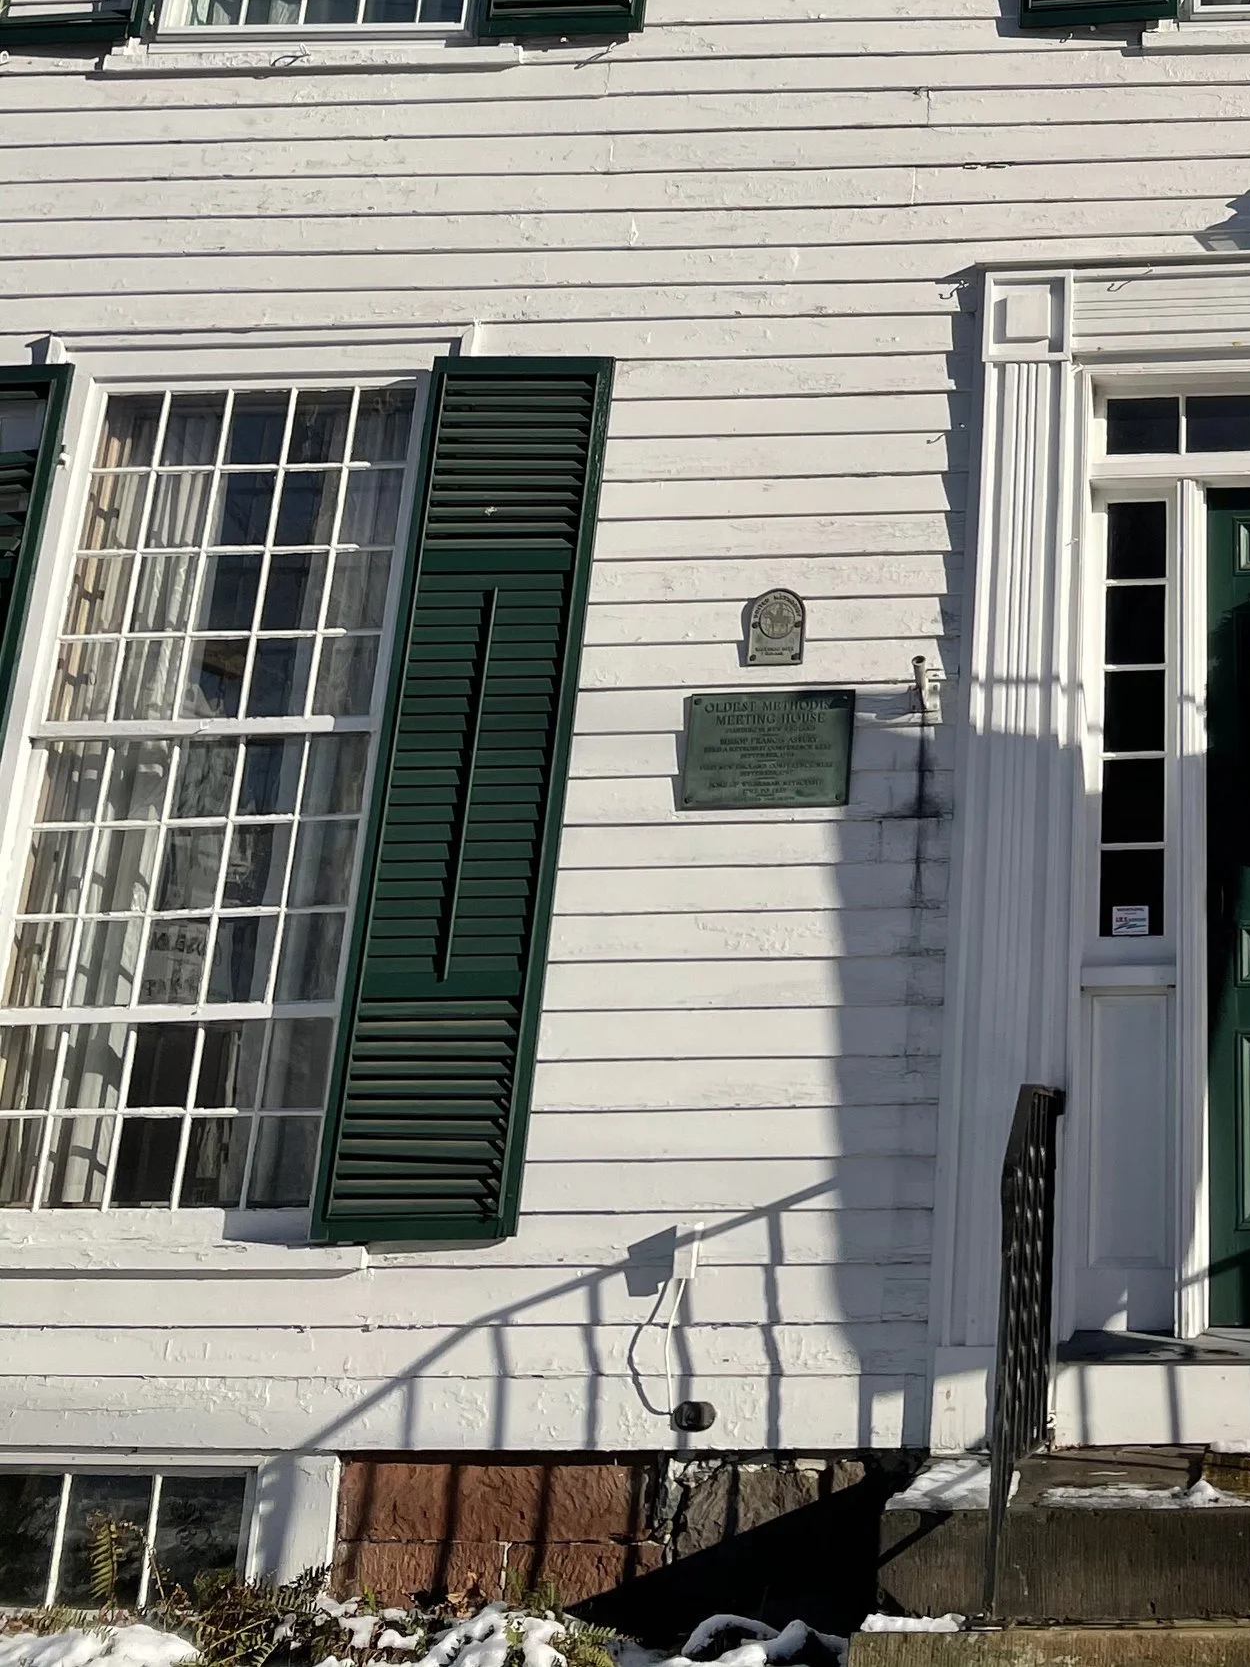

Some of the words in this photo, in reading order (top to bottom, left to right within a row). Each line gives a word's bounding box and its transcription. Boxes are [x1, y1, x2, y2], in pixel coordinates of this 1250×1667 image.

[705, 702, 755, 713] OLDEST
[763, 700, 831, 711] METHODIS
[716, 713, 776, 725] MEETING
[782, 713, 825, 724] HOUSE
